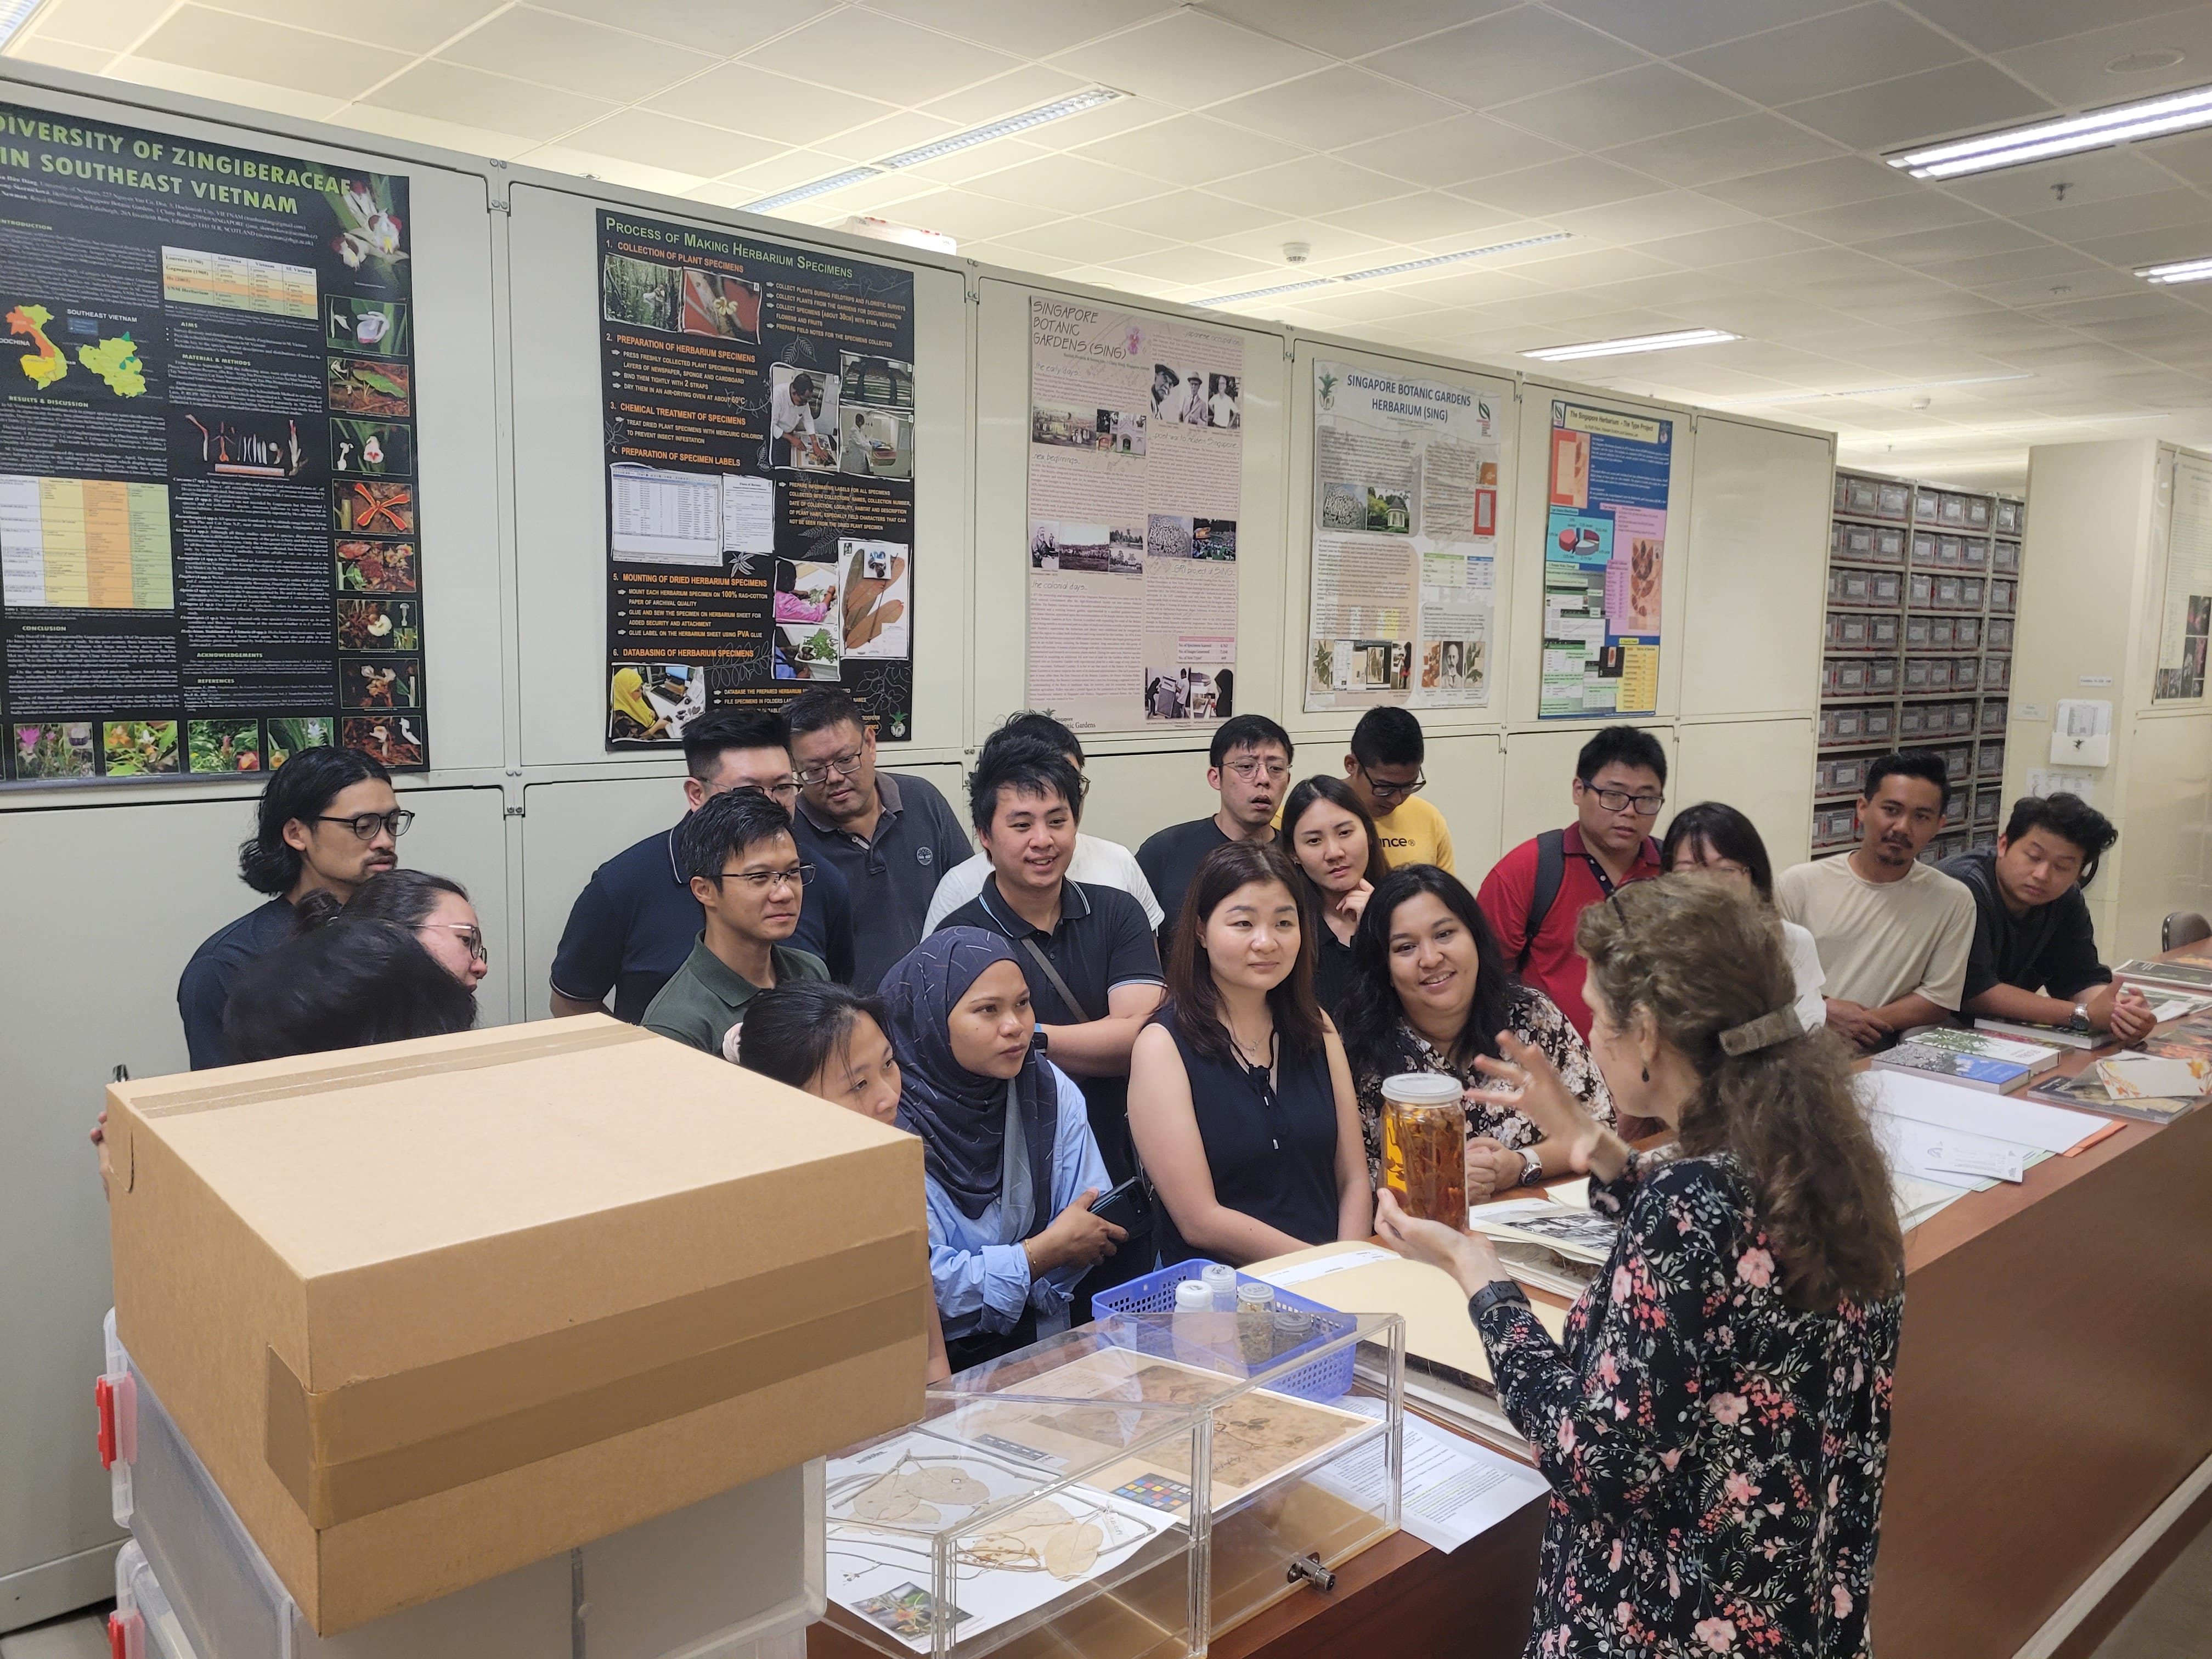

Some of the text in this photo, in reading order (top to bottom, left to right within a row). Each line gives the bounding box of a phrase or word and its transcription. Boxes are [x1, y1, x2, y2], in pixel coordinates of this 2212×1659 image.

[133, 140, 163, 161] OF
[0, 146, 30, 168] IN
[40, 154, 182, 194] SOUTHEAST
[190, 180, 298, 215] VIETNAM
[0, 219, 52, 230] NTRODUCTION
[606, 239, 743, 273] 1. COLLECTION OF PLANT SPECIMENS
[67, 308, 137, 323] SOUTHEAST VIETNAM
[776, 313, 797, 322] FLOWERS
[808, 318, 822, 326] FRUITS
[1034, 301, 1098, 324] SINGAPORE
[1034, 317, 1080, 336] BOTANIC
[606, 332, 755, 363] 2. PREPARATION OF HERBARIUM SPECIMENS
[1034, 332, 1126, 359] GARDENS (SING)
[182, 354, 214, 362] MATERIAL
[222, 358, 251, 366] METHODS
[623, 351, 639, 359] PRESS
[640, 353, 661, 362] FRESHLY
[662, 357, 691, 366] COLLECTED
[708, 363, 735, 373] SPECIMENS
[736, 367, 758, 376] BETWEEN
[623, 362, 642, 370] LAYERS
[651, 365, 681, 376] NEWSPAPER,
[682, 370, 703, 379] SPONGE
[715, 375, 744, 384] CARDBOARD
[663, 388, 691, 398] AIR-DRYING
[714, 394, 731, 403] ABOUT
[1347, 375, 1471, 407] SINGAPORE BOTANIC GARDENS
[9, 396, 38, 404] RESULTS
[47, 399, 89, 408] DISCUSSION
[1372, 398, 1421, 417] HERBARIUM
[1424, 407, 1448, 423] (SING)
[610, 401, 746, 425] 3. CHEMICAL TREATMENT OF SPECIMENS
[1578, 413, 1598, 423] Singapore
[1599, 417, 1619, 426] Herbarium
[1631, 422, 1639, 430] Type
[1640, 424, 1654, 432] Project
[634, 430, 656, 438] PREVENT
[675, 435, 704, 444] INFESTATION
[675, 425, 702, 433] SPECIMENS
[715, 429, 740, 437] MERCURIC
[741, 432, 764, 440] CHLORIDE
[611, 445, 740, 466] 4. PREPARATION OF SPECIMEN LABELS
[623, 573, 657, 582] MOUNTING
[669, 575, 690, 584] DRIED
[691, 576, 730, 585] HERBARIUM
[731, 578, 767, 587] SPECIMENS
[717, 649, 754, 657] SPECIMENS
